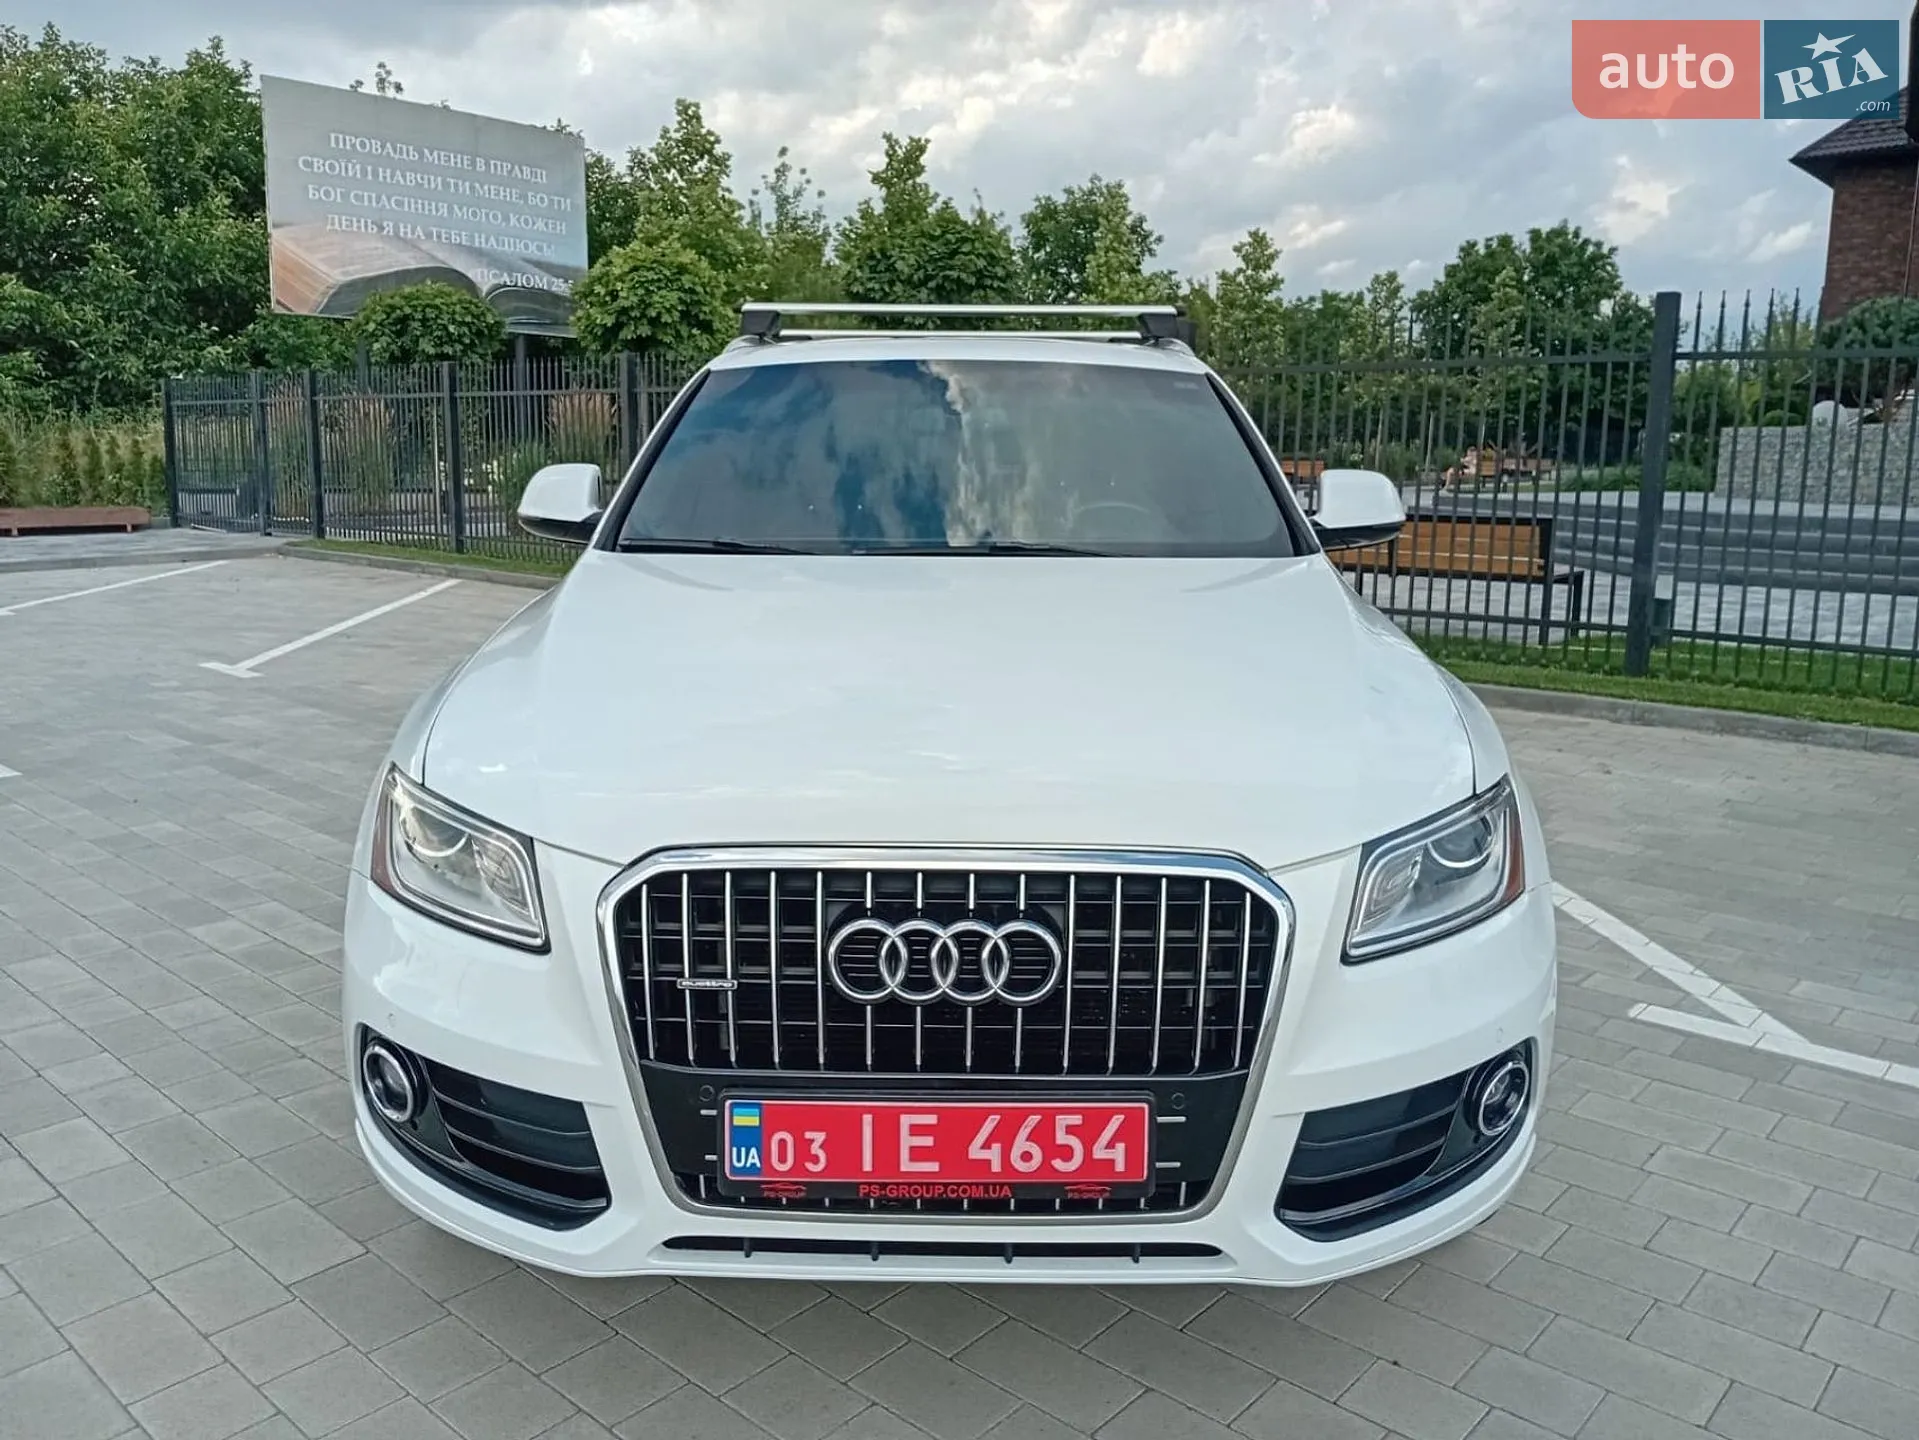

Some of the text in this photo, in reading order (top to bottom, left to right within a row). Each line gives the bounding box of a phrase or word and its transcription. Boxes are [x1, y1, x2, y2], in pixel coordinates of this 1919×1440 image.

[329, 132, 547, 184] ПРОВАДЬ МЕНЕ В ПРАВДІ
[298, 155, 361, 179] СВОЇЙ
[366, 165, 373, 180] І
[378, 167, 443, 191] НАВЧИ
[446, 177, 471, 195] ТИ
[527, 191, 548, 208] БО
[550, 195, 572, 212] ТИ
[307, 184, 566, 235] БОГ СПАСІННЯ МОГО, КОЖЕН
[326, 214, 378, 234] ДЕНЬ
[383, 220, 394, 236] Я
[399, 222, 426, 240] НА
[429, 226, 471, 246] ТЕБЕ
[473, 267, 548, 290] ПСАЛОМ
[732, 1146, 761, 1168] UA
[770, 1131, 827, 1173] 03
[968, 1114, 1126, 1173] 4654
[859, 1184, 1012, 1198] PS-GROUP.COM.UA
